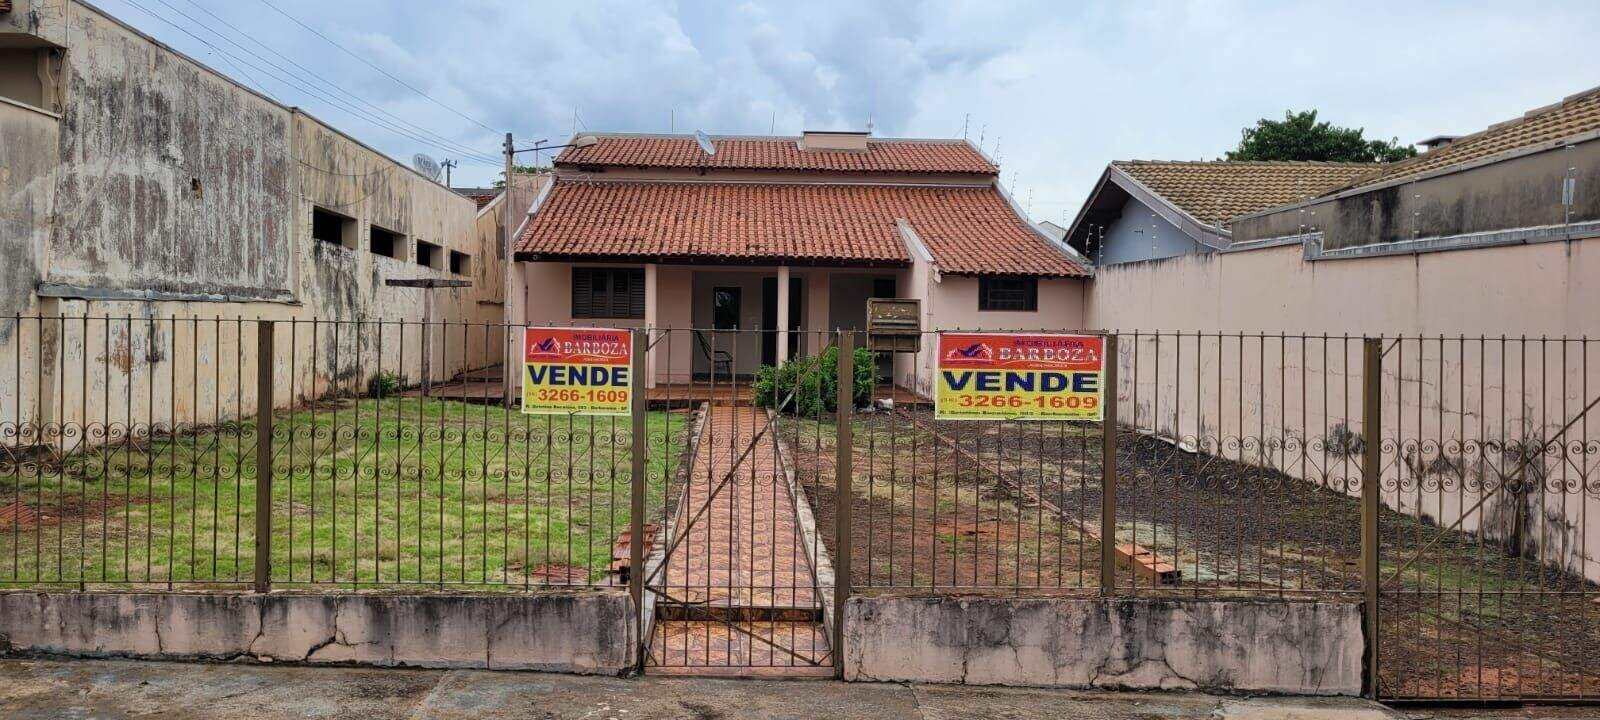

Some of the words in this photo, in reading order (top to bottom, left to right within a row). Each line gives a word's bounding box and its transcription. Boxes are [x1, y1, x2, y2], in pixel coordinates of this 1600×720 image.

[563, 341, 628, 355] BARBOZA
[999, 347, 1098, 361] BARBOZA
[527, 365, 628, 387] VENDE
[942, 371, 1098, 392] VENDE
[538, 389, 628, 403] 3266-1609
[959, 394, 1098, 408] 3266-1609
